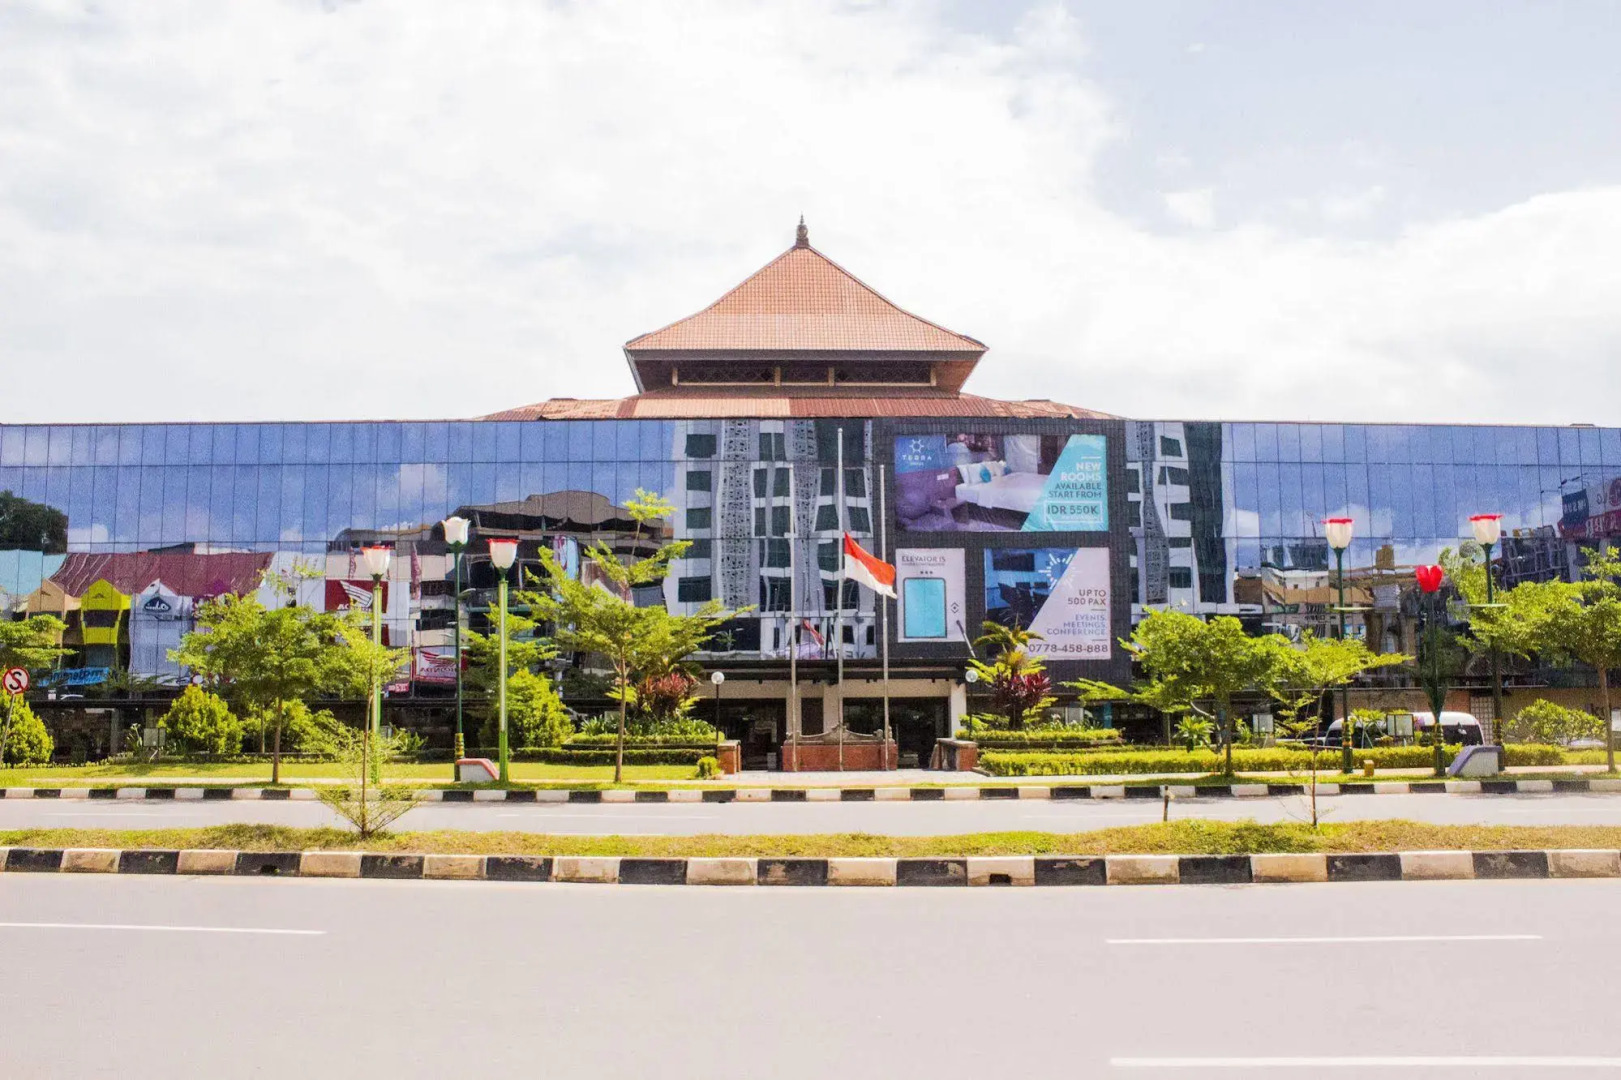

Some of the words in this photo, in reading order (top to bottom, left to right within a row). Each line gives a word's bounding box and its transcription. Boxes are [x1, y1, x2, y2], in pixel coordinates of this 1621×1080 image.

[1076, 462, 1101, 471] NEW
[1061, 471, 1101, 481] ROOMS
[1055, 482, 1102, 490] AVAILABLE
[1047, 504, 1067, 515] IDR
[1070, 505, 1099, 515] 550K
[1079, 589, 1092, 597] UP
[1094, 589, 1106, 597] TO
[1067, 597, 1086, 605] 500
[1088, 598, 1106, 606] PAX
[1028, 644, 1108, 653] 0778-458-888
